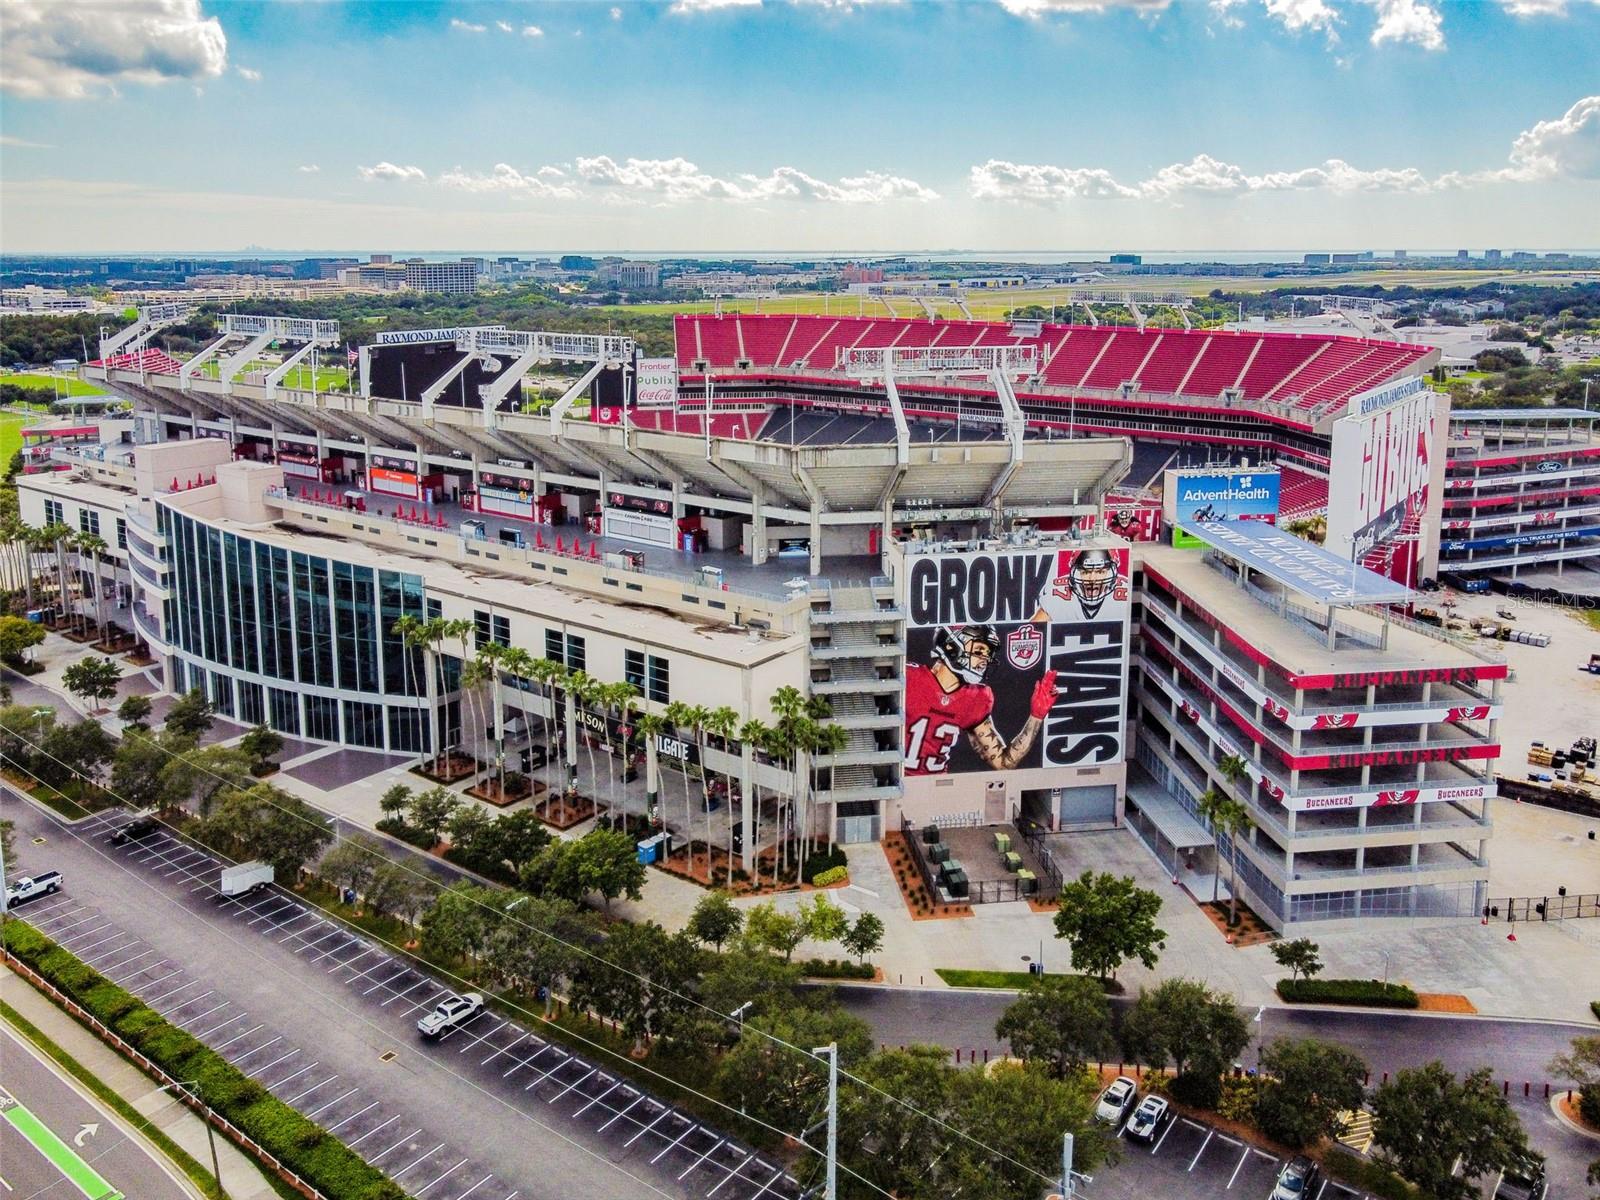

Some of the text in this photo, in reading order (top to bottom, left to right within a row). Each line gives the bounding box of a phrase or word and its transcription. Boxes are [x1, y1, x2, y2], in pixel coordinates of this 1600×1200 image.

[382, 331, 433, 345] RAYMOND
[639, 362, 671, 370] Frontier
[636, 376, 673, 385] Publix
[1183, 487, 1270, 501] AdventHealth
[1448, 542, 1466, 551] Ford
[1505, 536, 1529, 545] OFFICIAL
[910, 554, 1054, 626] GRONK
[1045, 620, 1124, 765] EVANS
[563, 711, 605, 733] JMESON
[905, 717, 960, 772] 13
[1437, 787, 1484, 799] BUCCANEERS
[1306, 796, 1353, 808] BUCCANEERS
